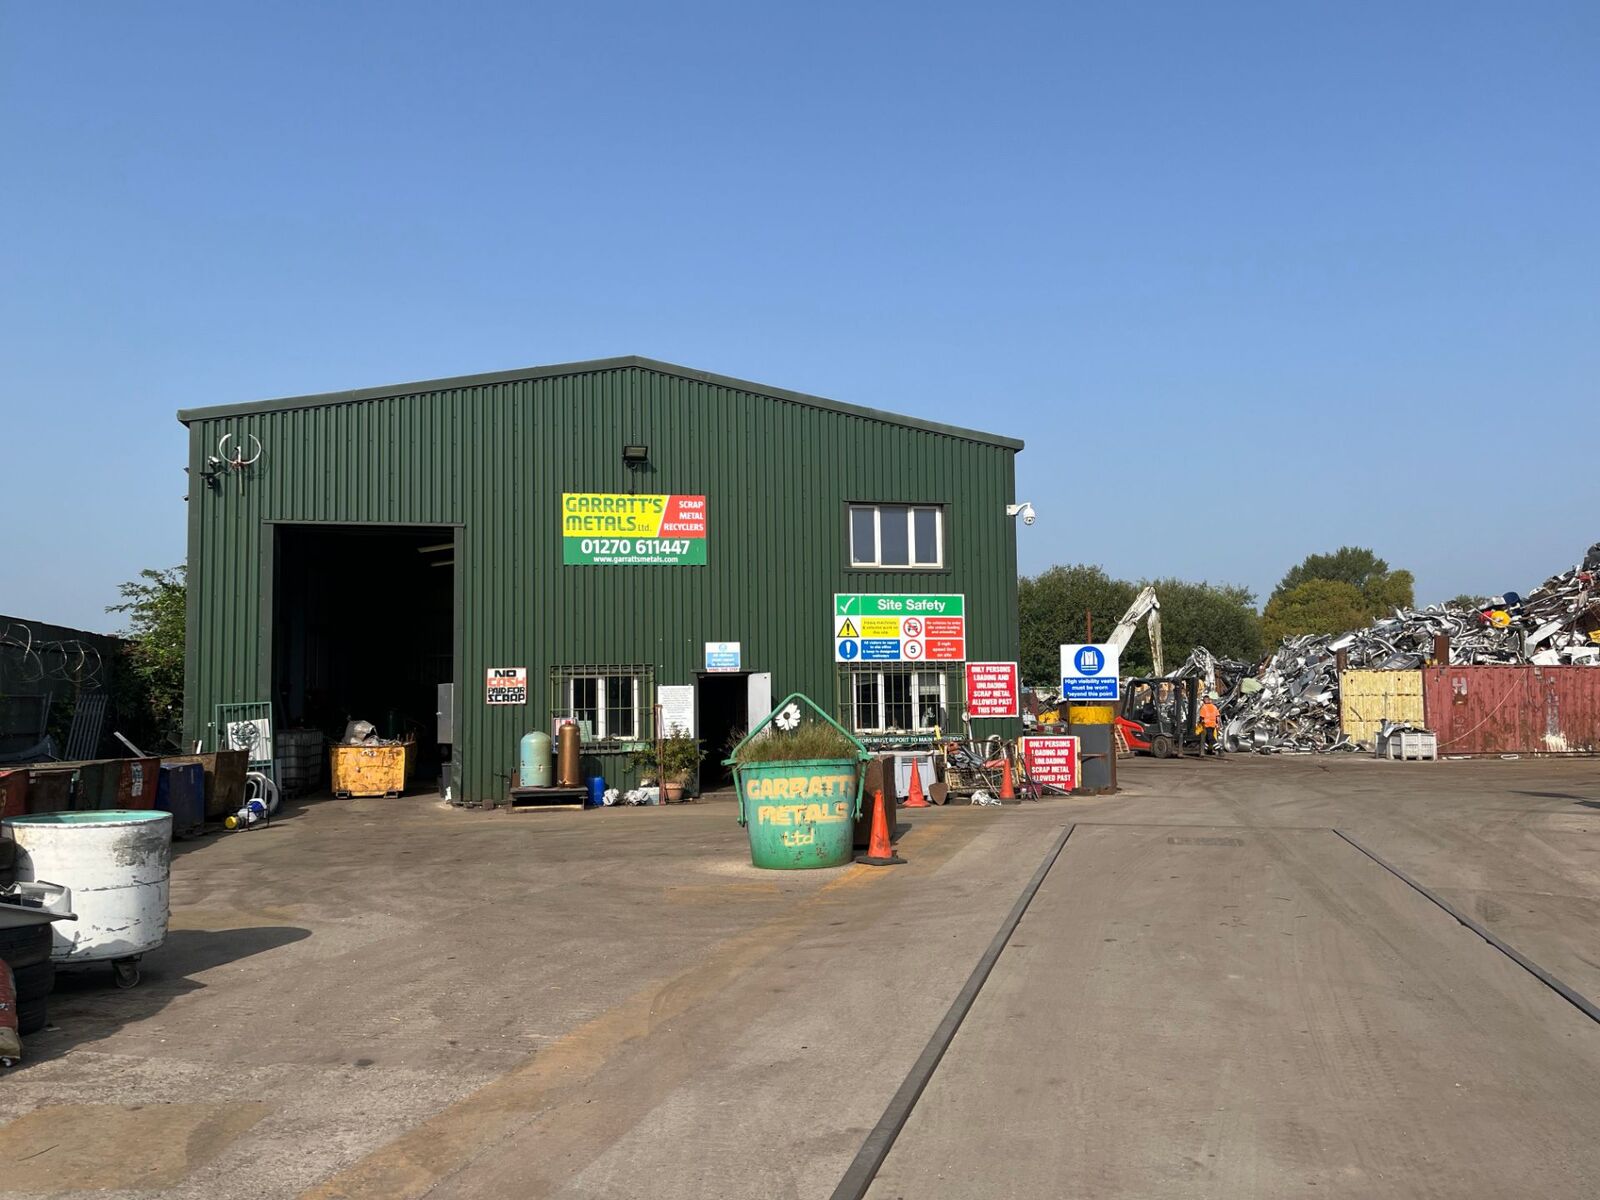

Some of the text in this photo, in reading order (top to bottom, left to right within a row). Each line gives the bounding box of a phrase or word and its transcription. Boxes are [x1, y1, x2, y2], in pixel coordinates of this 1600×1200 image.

[566, 496, 663, 513] GARRATT'S
[678, 500, 704, 509] SCRAP
[566, 515, 636, 532] METALS
[581, 540, 690, 554] 01270 611447
[878, 599, 946, 612] Site Safety
[910, 645, 916, 653] 5
[488, 677, 526, 687] CASH
[488, 694, 525, 702] SCRAP
[758, 803, 849, 825] METALS
[783, 828, 814, 847] Ltd
